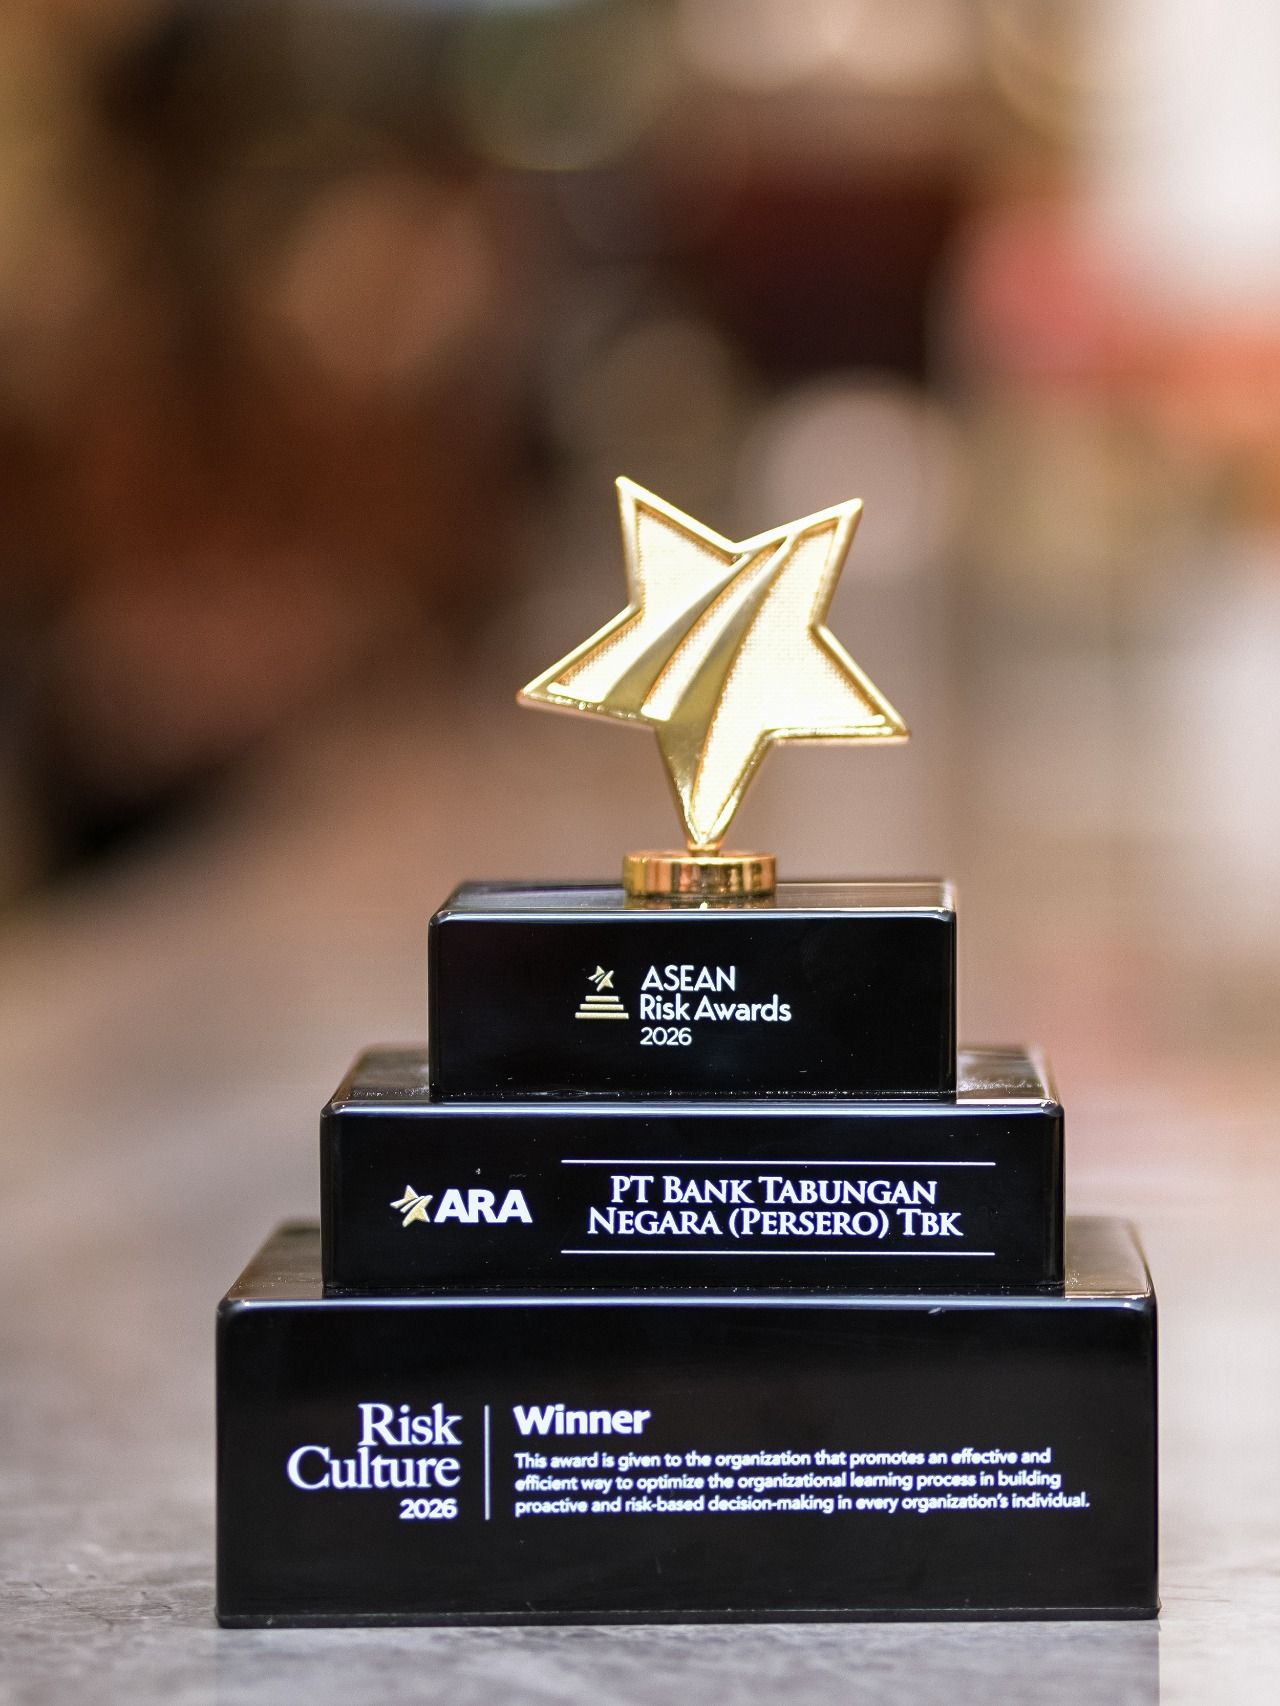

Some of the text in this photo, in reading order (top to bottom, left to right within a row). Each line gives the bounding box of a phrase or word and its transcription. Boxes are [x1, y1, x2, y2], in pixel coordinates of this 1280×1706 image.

[641, 965, 735, 991] ASEAN
[640, 994, 792, 1021] Risk Awards
[640, 1027, 692, 1045] 2026
[611, 1175, 937, 1205] PT BANK TABUNGAN
[434, 1189, 533, 1223] ARA
[587, 1207, 964, 1239] NEGARA (PERSERO) TBK
[358, 1403, 462, 1446] Risk
[512, 1404, 651, 1436] Winner
[287, 1444, 460, 1490] Culture
[514, 1447, 1051, 1472] This award is given to the organization that promotes an effective and
[514, 1469, 1061, 1495] efficient way to optimize the organizational learning process in building
[399, 1498, 458, 1520] 2026
[514, 1497, 588, 1518] proactive
[591, 1496, 621, 1513] and
[625, 1495, 704, 1513] risk-based
[708, 1494, 834, 1514] decision-making
[837, 1494, 852, 1510] in
[855, 1497, 899, 1514] every
[1011, 1491, 1091, 1509] individual.
